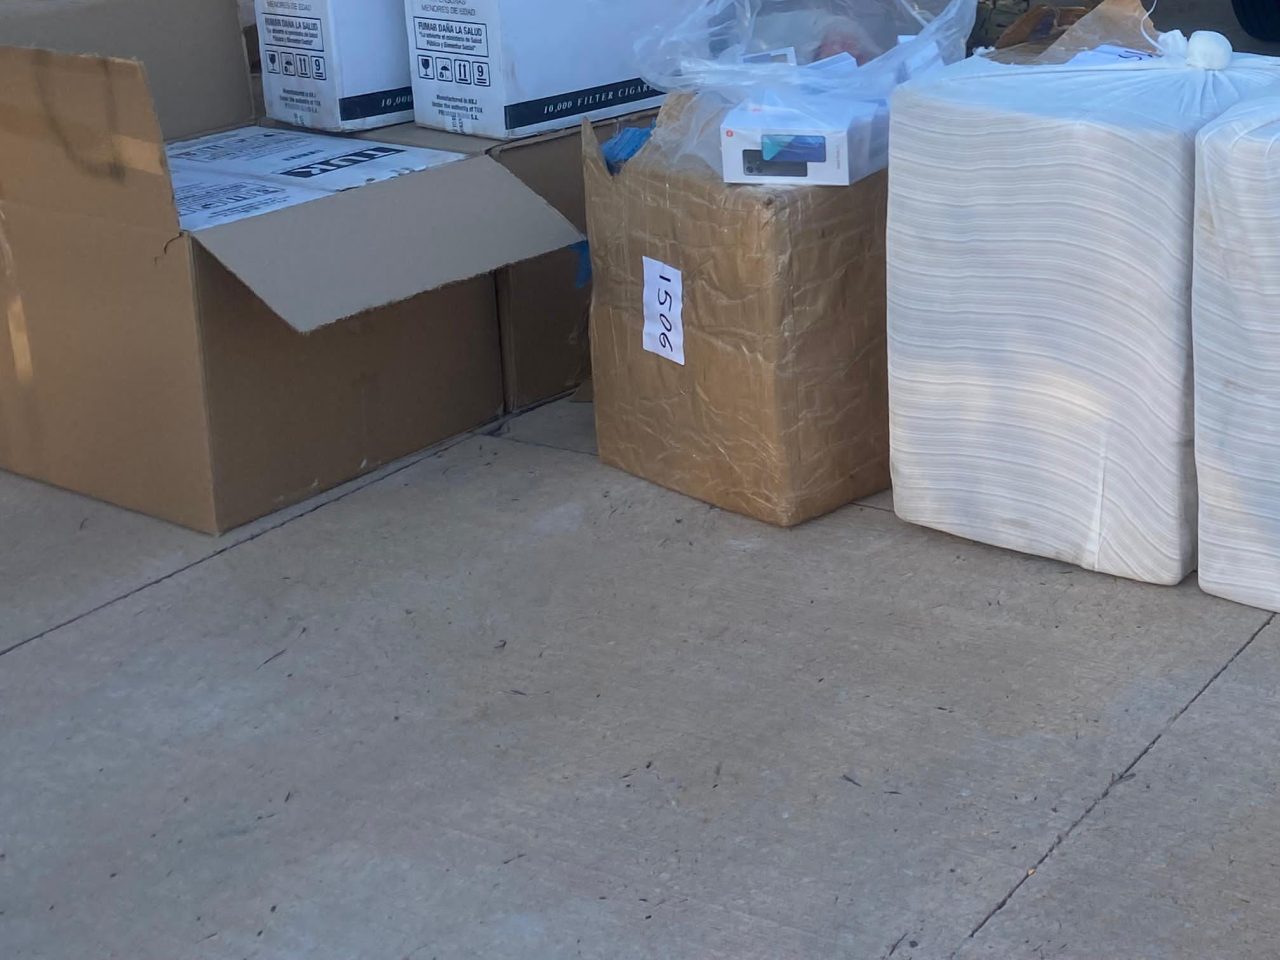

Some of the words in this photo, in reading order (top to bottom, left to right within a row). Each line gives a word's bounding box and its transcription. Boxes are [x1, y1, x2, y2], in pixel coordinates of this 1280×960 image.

[314, 58, 321, 71] 9
[476, 65, 484, 78] 9
[543, 100, 573, 114] 10,000
[577, 90, 614, 107] FILTER
[618, 83, 655, 98] CIGAR
[657, 274, 674, 352] 1506
